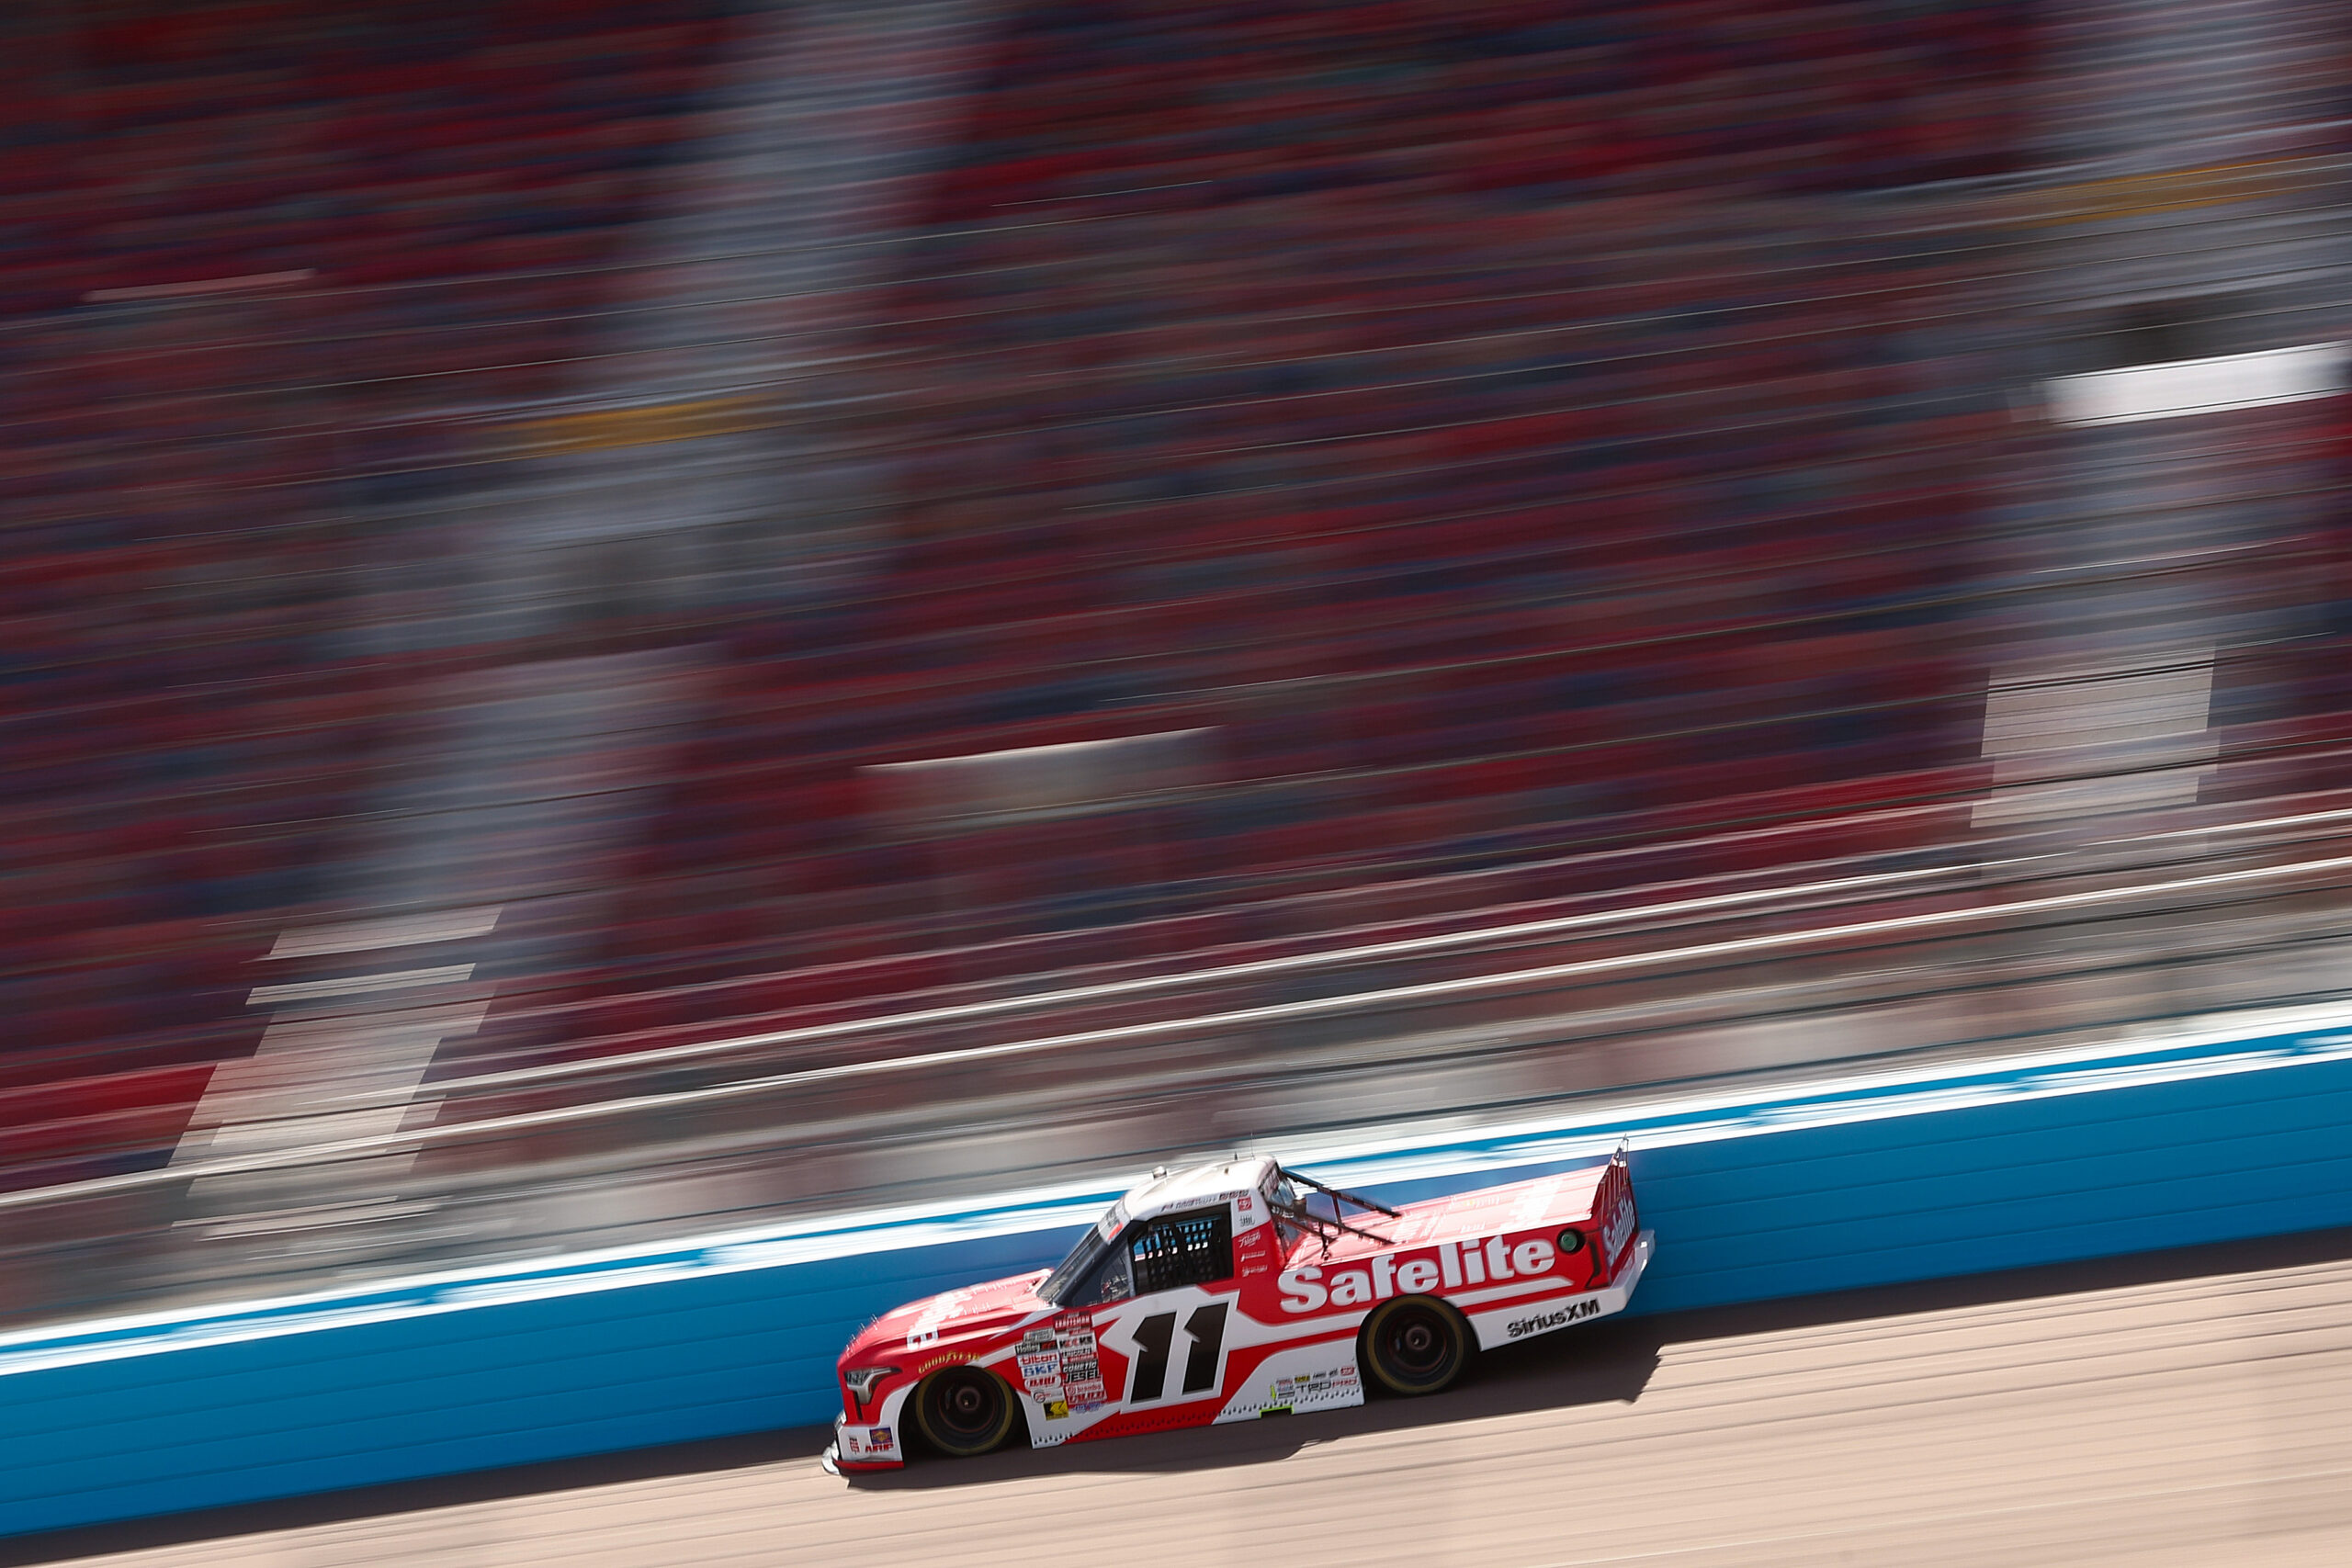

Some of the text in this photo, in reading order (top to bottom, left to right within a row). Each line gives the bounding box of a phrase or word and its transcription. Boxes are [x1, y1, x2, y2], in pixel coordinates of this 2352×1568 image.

[1278, 1234, 1555, 1314] Safelite
[1507, 1298, 1602, 1338] SiriusXM
[919, 1350, 981, 1374] GOODYEAR
[1021, 1353, 1057, 1366] tilton
[1130, 1302, 1229, 1404] 11
[1023, 1364, 1057, 1377] SKF
